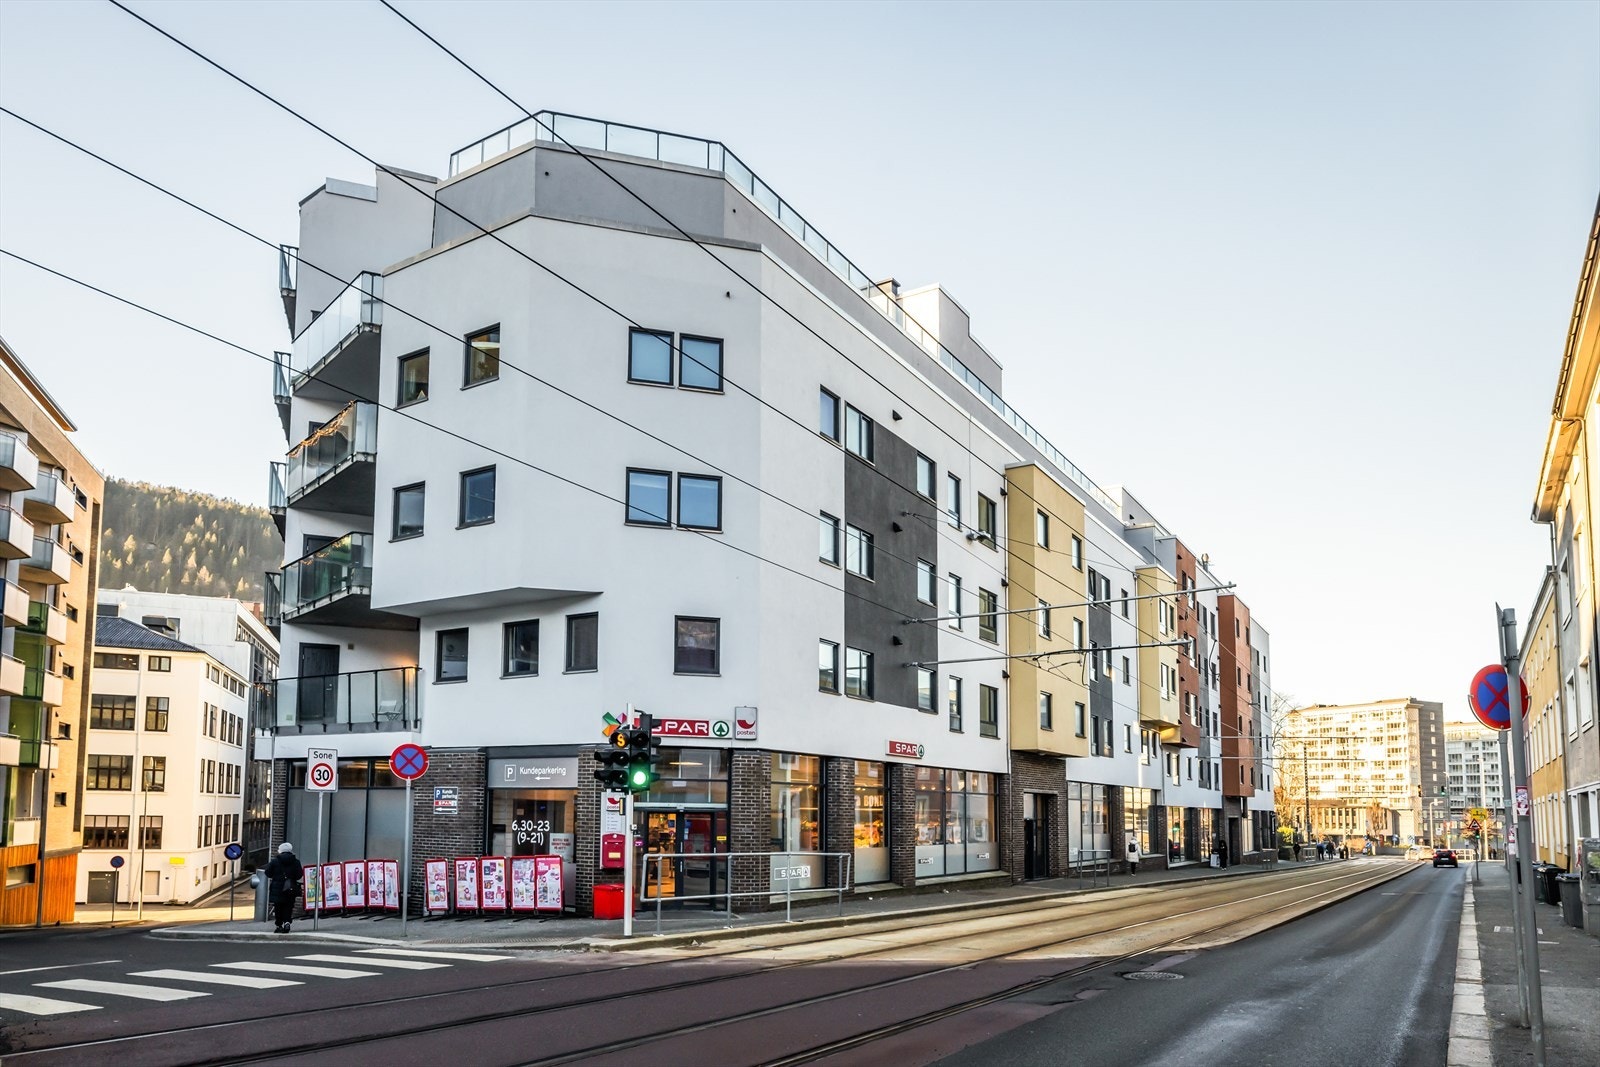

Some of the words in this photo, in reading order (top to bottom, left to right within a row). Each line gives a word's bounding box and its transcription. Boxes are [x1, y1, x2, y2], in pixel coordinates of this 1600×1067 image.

[895, 743, 917, 754] SPAR
[313, 751, 333, 759] Sone
[315, 769, 330, 781] 30
[507, 767, 513, 778] P
[519, 766, 567, 776] Kundeparkering
[511, 820, 550, 831] 6.30-23
[517, 831, 544, 846] (9-21)
[780, 868, 802, 878] SAR
